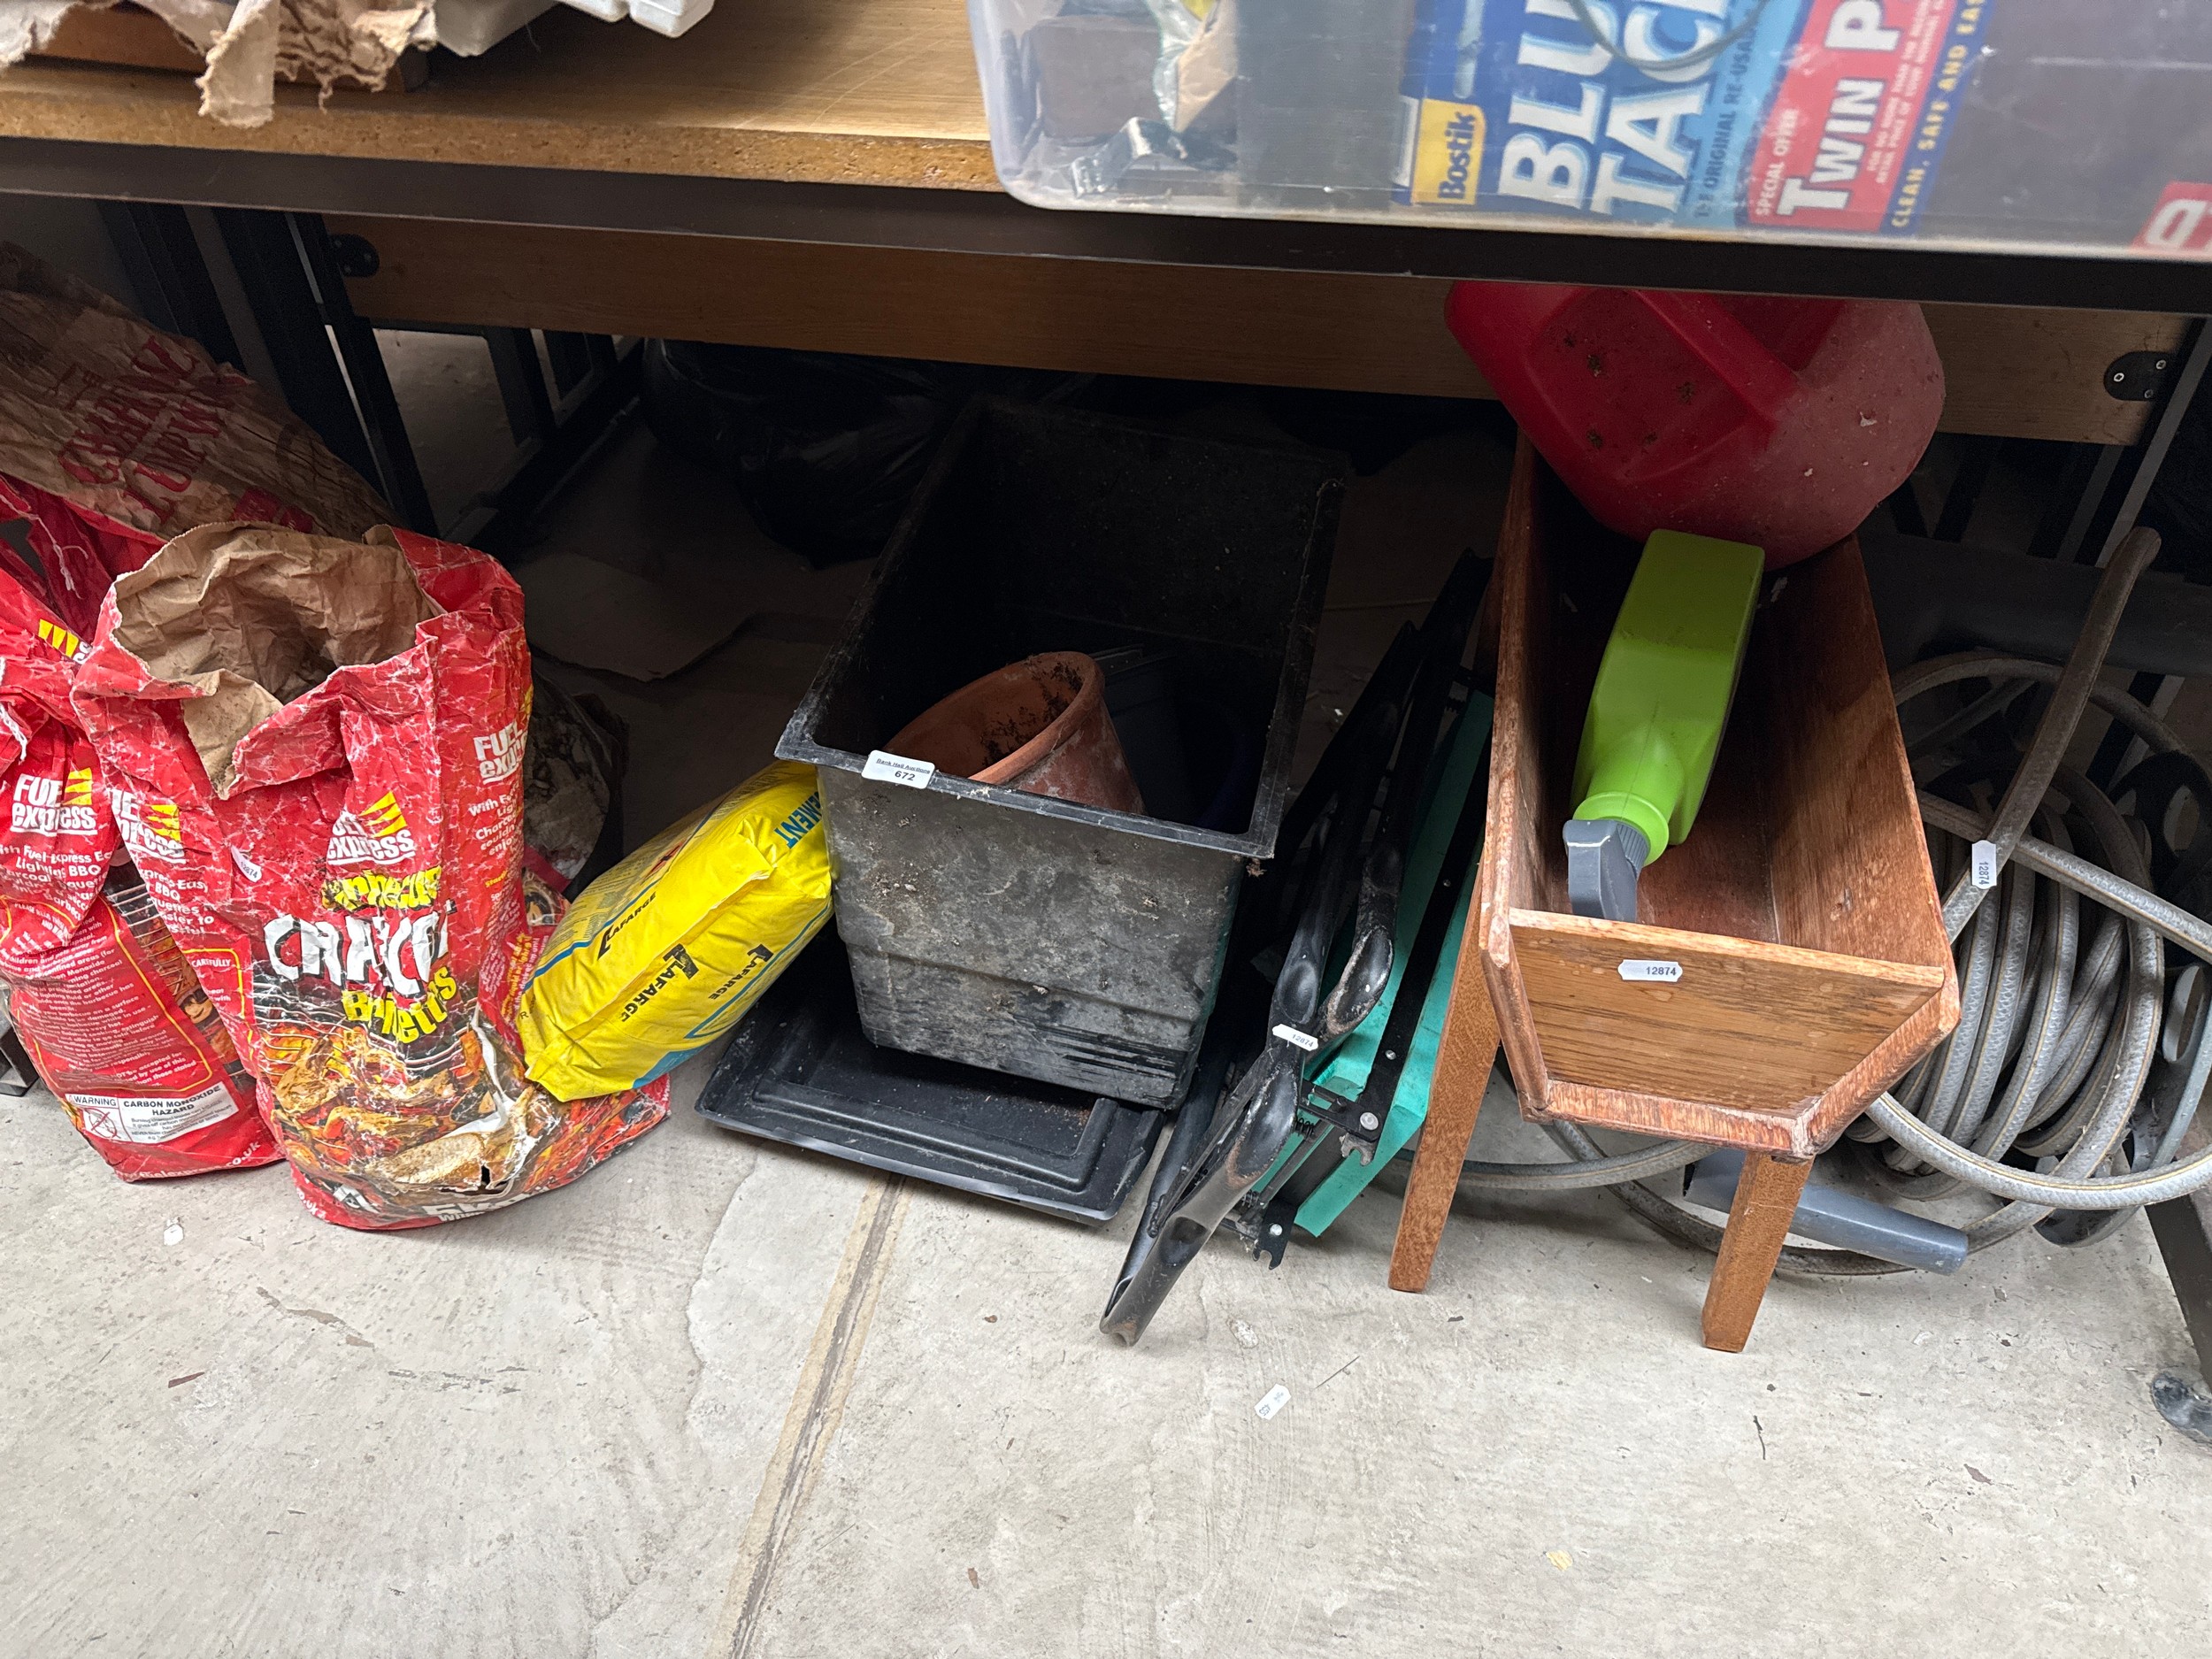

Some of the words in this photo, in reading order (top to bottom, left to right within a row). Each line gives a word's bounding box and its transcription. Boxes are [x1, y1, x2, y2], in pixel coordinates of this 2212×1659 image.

[1938, 44, 1968, 93] AND
[1438, 111, 1476, 200] Bostik
[1703, 111, 1736, 188] ORIGINAL
[1776, 77, 1886, 217] TWIN
[1755, 161, 1785, 217] SPECIAL
[1773, 109, 1800, 157] OFFER
[473, 719, 524, 762] FUEL
[875, 757, 892, 767] Bank
[904, 764, 931, 774] Auctions
[895, 770, 916, 781] 672
[468, 798, 499, 817] With
[23, 844, 47, 863] Fuel
[68, 864, 102, 877] BBQ
[1978, 861, 1990, 886] 12874
[155, 881, 181, 901] BBQ
[198, 915, 215, 926] to
[606, 892, 657, 941] LAFARGE
[90, 934, 108, 946] from
[77, 954, 100, 965] areas
[100, 948, 116, 959] (for
[66, 959, 105, 977] Monoxide
[89, 959, 123, 977] charcoal
[707, 953, 764, 1001] LAFARGE
[1646, 966, 1677, 976] 12874
[94, 984, 115, 996] other
[119, 982, 135, 993] has
[620, 959, 686, 1023] LAFARGE
[111, 995, 140, 1010] surface
[132, 1007, 147, 1017] use
[120, 1014, 159, 1034] extinguish
[1291, 1033, 1314, 1048] 12874
[138, 1054, 173, 1072] accepted
[140, 1070, 153, 1080] by
[153, 1064, 168, 1073] use
[168, 1061, 177, 1070] of
[152, 1069, 173, 1081] those
[173, 1060, 197, 1073] stated
[73, 1095, 117, 1107] WARNING
[165, 1085, 221, 1108] MONOXIDE
[152, 1103, 195, 1116] HAZARD
